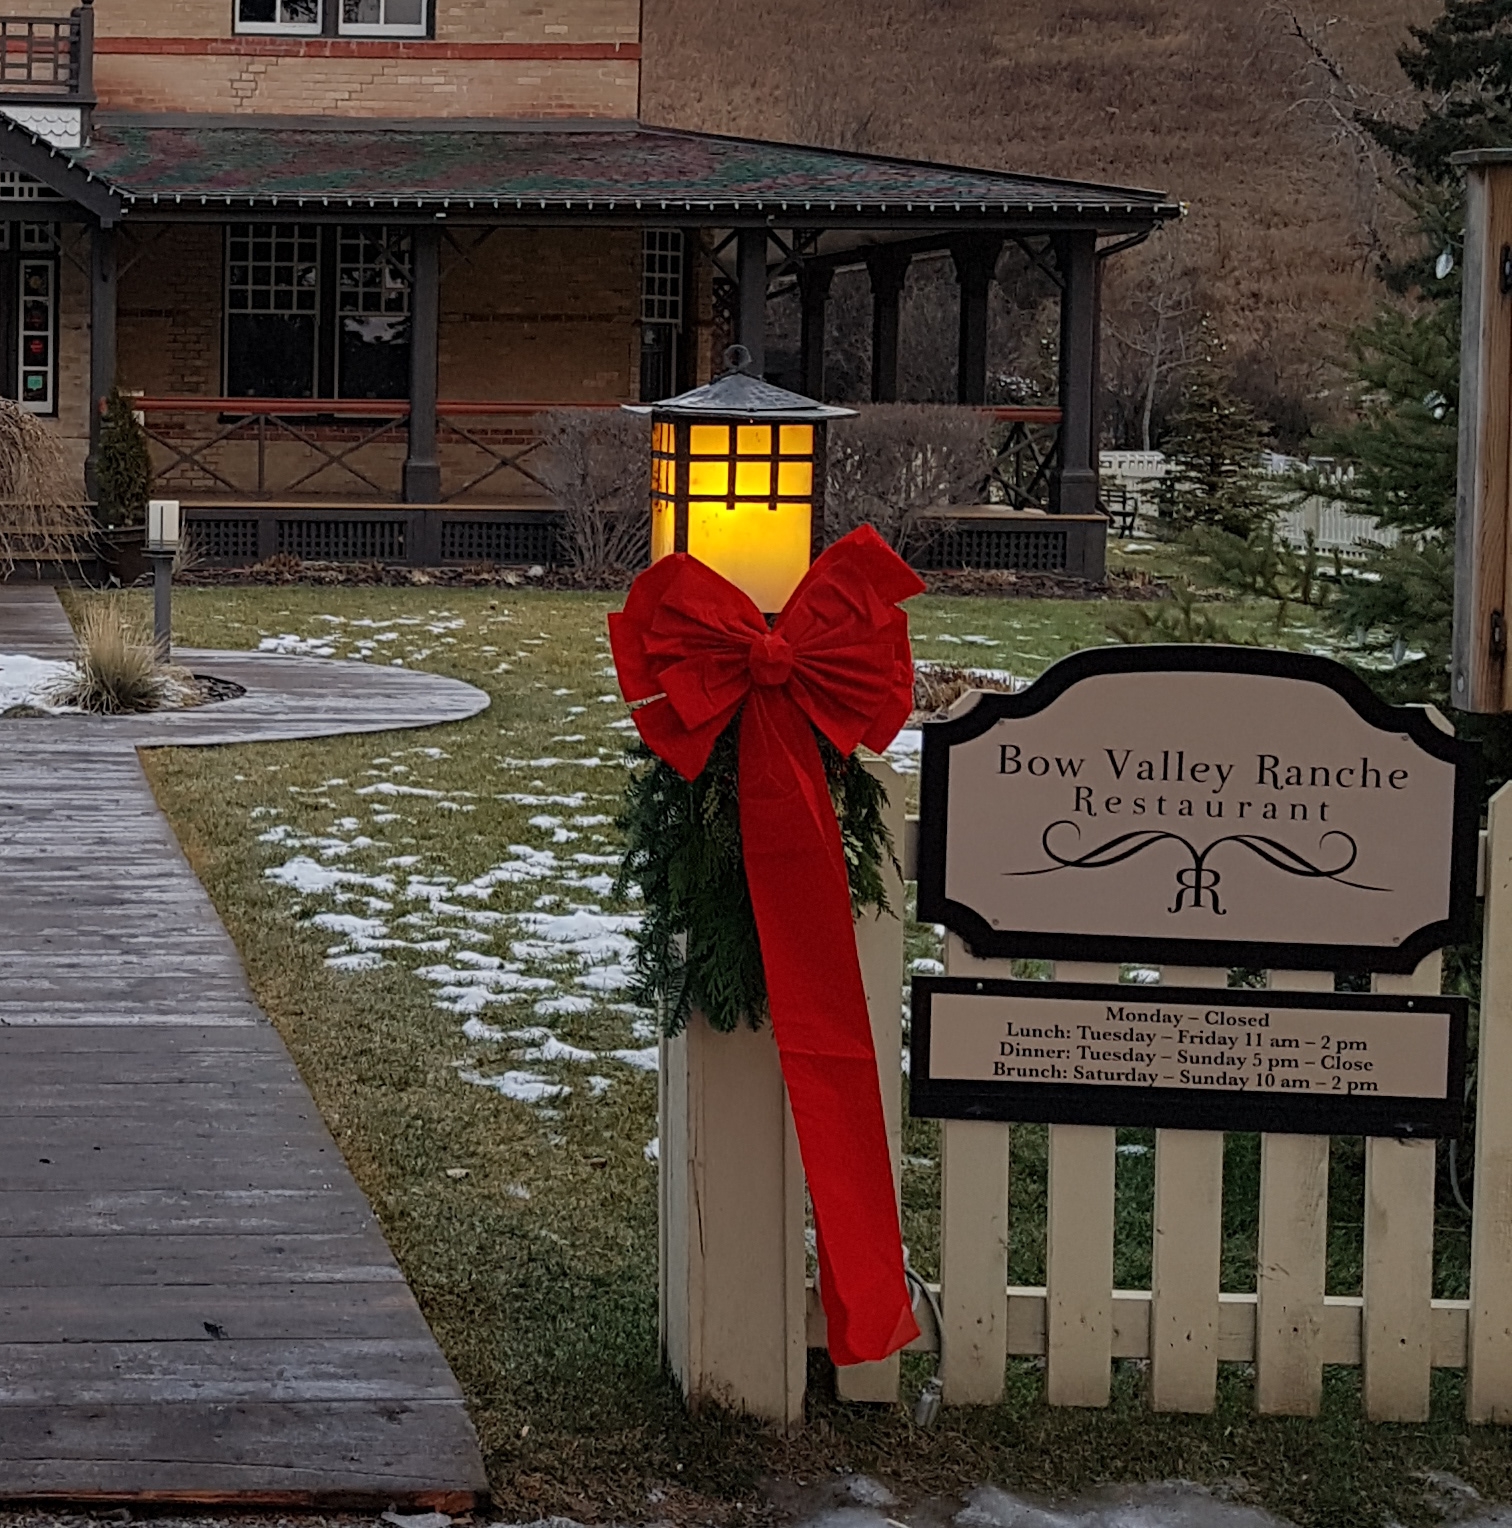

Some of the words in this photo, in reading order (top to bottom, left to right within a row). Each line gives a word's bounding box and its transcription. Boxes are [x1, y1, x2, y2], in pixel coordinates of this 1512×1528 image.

[998, 745, 1085, 778] Bow
[1104, 749, 1235, 794] Valley
[1256, 755, 1409, 790] Ranche
[1073, 786, 1330, 821] Restaurant
[1106, 1007, 1183, 1027] Monday
[1205, 1011, 1270, 1027] Closed
[1007, 1022, 1071, 1039] Lunch:
[1077, 1025, 1156, 1047] Tuesday
[1177, 1030, 1238, 1050] Friday
[1245, 1033, 1262, 1047] 11
[1270, 1037, 1300, 1048] am
[1321, 1035, 1330, 1050] 2
[1336, 1039, 1367, 1054] pm
[1000, 1042, 1070, 1059] Dinner:
[1077, 1045, 1156, 1067] Tuesday
[1177, 1050, 1247, 1070] Sunday
[1252, 1053, 1262, 1067] 5
[1268, 1057, 1298, 1071] pm
[1321, 1055, 1373, 1071] Close
[993, 1062, 1067, 1079] Brunch:
[1073, 1065, 1158, 1087] Saturday
[1180, 1070, 1249, 1090] Sunday
[1256, 1074, 1275, 1087] 10
[1280, 1077, 1310, 1088] am
[1332, 1076, 1341, 1090] 2
[1347, 1080, 1378, 1094] pm
